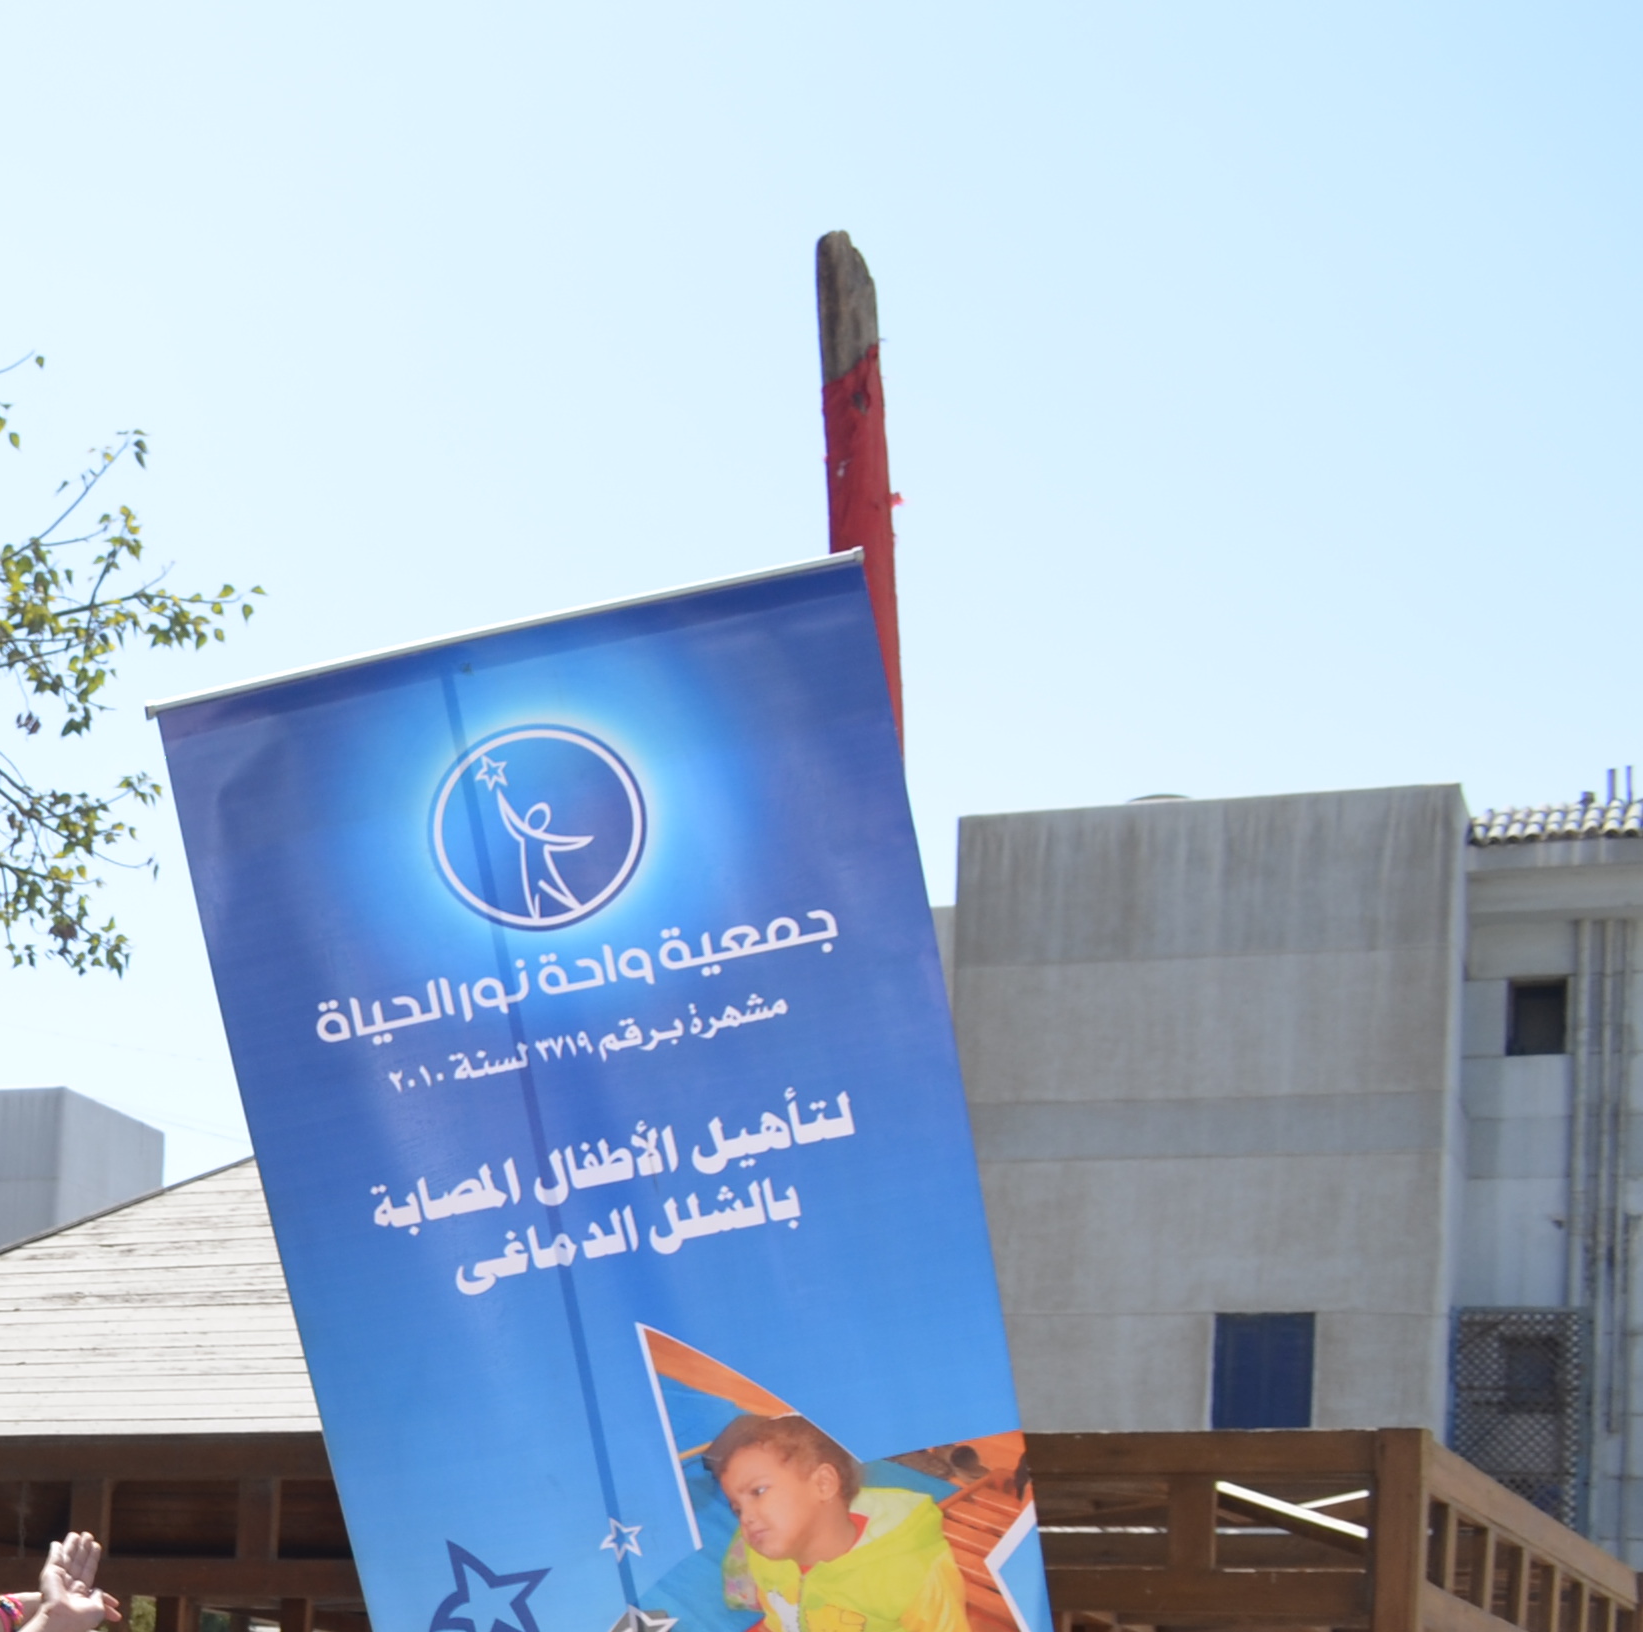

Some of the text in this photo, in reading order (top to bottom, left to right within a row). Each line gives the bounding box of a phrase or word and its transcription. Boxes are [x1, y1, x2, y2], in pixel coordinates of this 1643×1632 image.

[316, 908, 839, 1045] جمعية واحة نور الحياة
[599, 1017, 684, 1062] برقم
[690, 993, 788, 1038] مشهرة
[453, 1041, 529, 1082] لسنة
[369, 1087, 855, 1236] لتأهيل الأطفال المصابة
[649, 1177, 802, 1255] بالشلل
